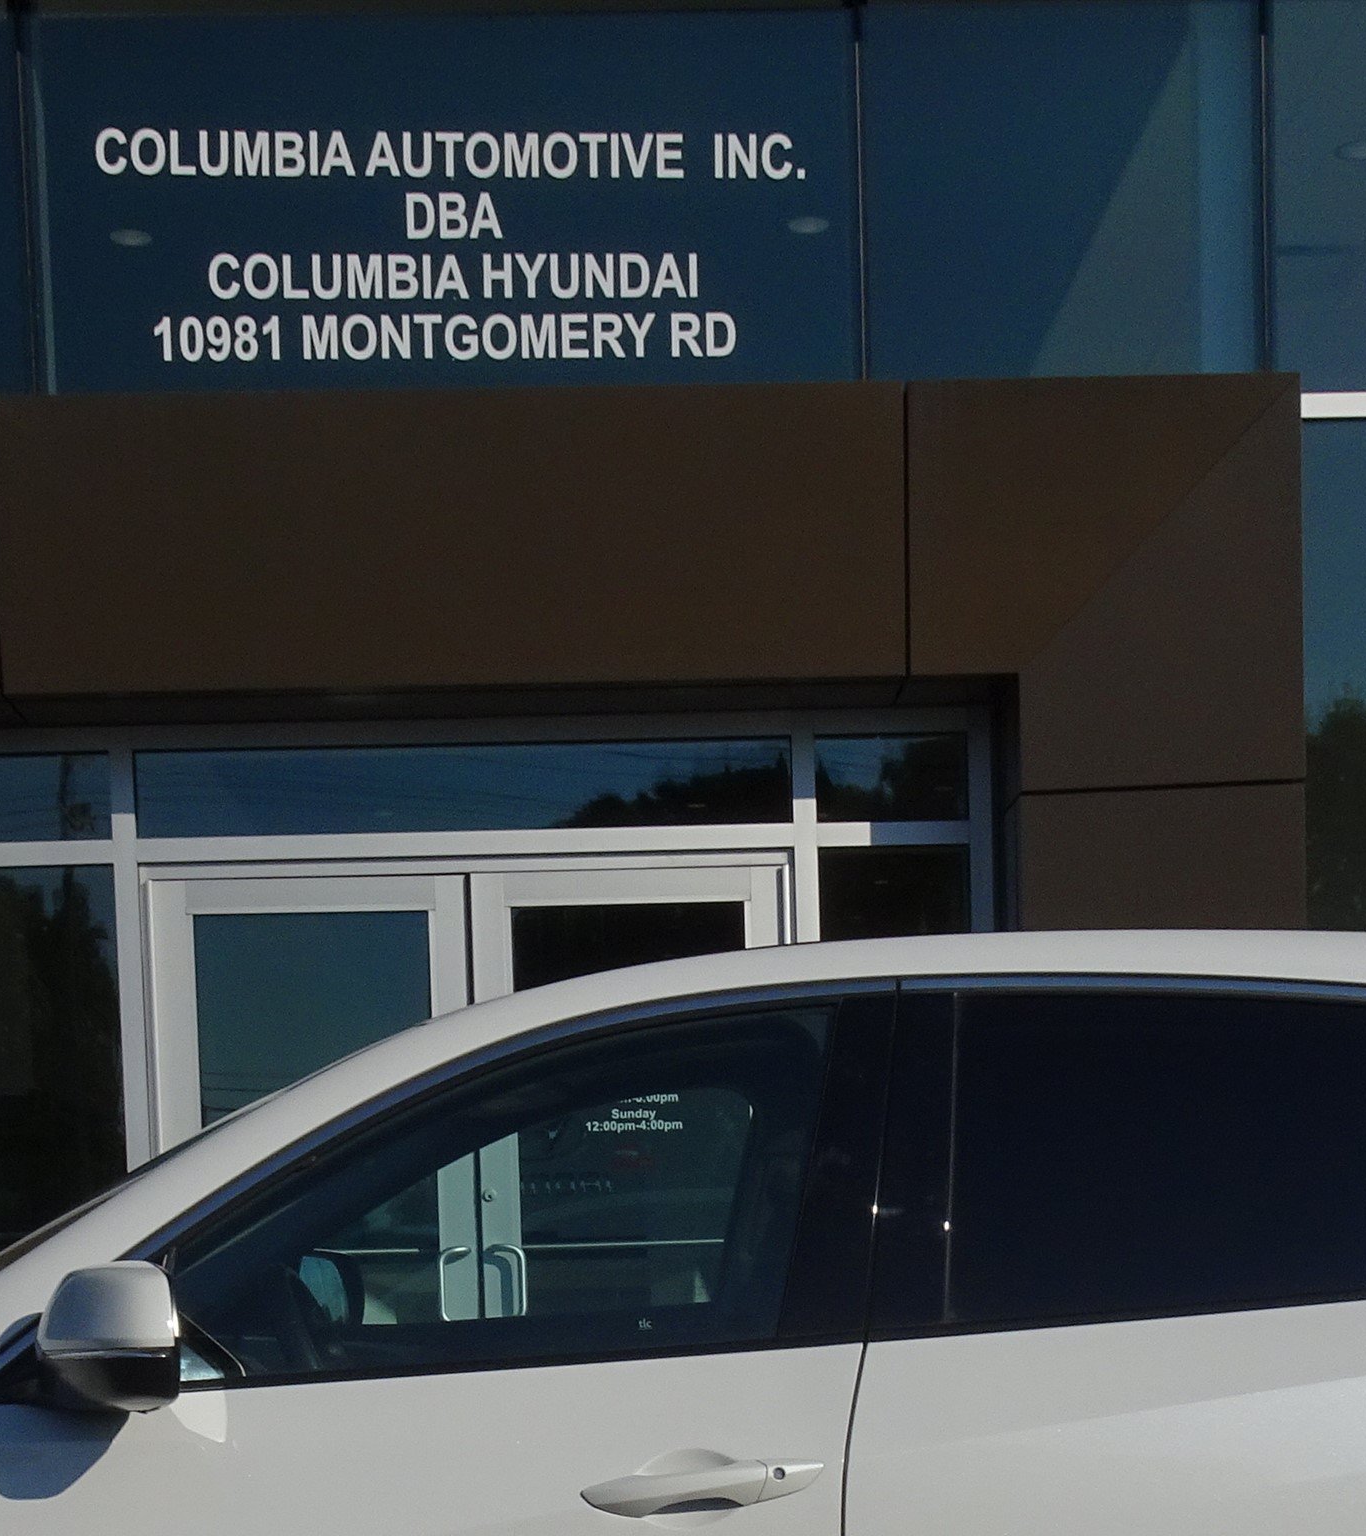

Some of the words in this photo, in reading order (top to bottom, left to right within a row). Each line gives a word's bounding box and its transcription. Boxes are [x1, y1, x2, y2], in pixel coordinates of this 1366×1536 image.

[95, 127, 356, 178] COLUMBIA
[365, 131, 685, 179] AUTOMOTIVE
[714, 133, 807, 180] INC.
[405, 191, 503, 240] DBA
[208, 253, 470, 300] COLUMBIA
[482, 252, 698, 299] HYUNDAI
[153, 315, 282, 362] 10981
[302, 312, 657, 360] MONTGOMERY
[670, 311, 737, 358] RD
[585, 1120, 683, 1133] 12:00pm-4:00pm
[611, 1108, 657, 1120] Sunday
